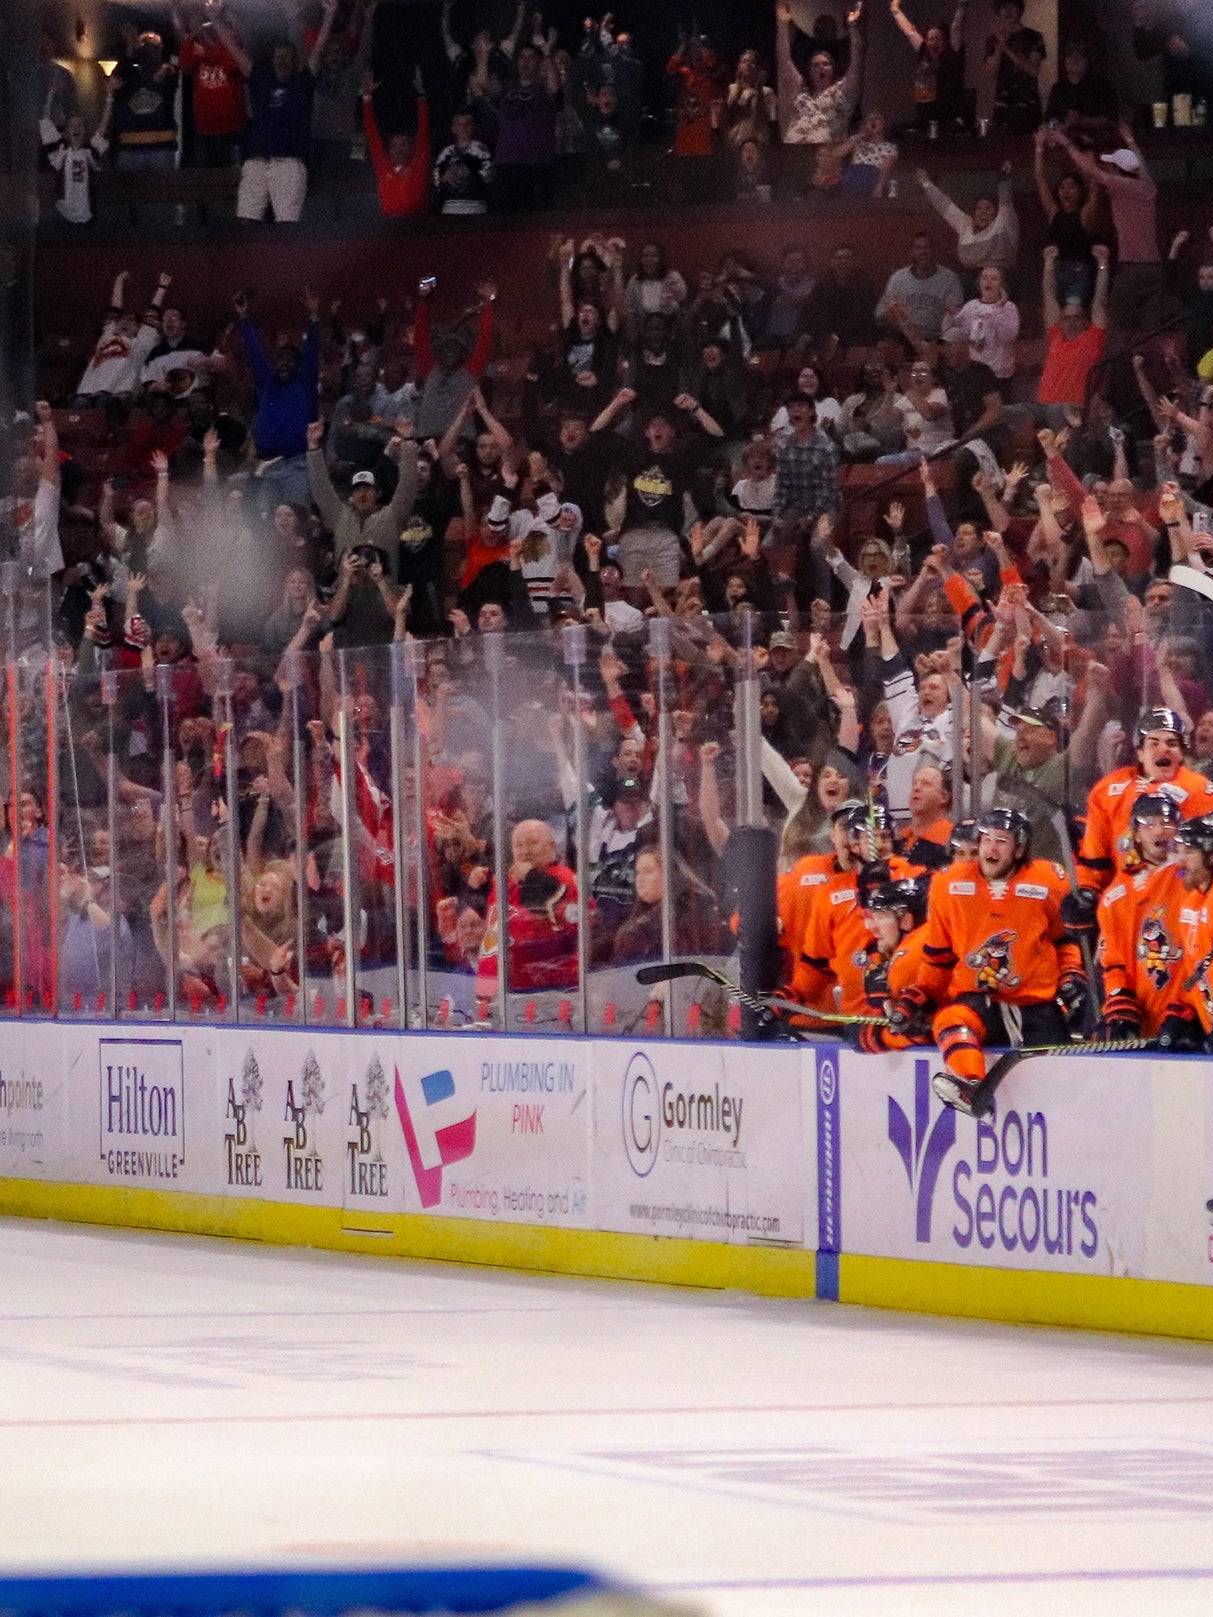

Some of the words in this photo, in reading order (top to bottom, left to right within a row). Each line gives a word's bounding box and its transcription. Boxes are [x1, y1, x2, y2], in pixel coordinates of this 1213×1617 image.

[107, 1065, 178, 1137] Hilton
[481, 1063, 556, 1092] PLUMBING
[559, 1064, 575, 1093] IN
[512, 1104, 545, 1134] PINK
[663, 1082, 743, 1148] Gormley
[107, 1150, 178, 1178] GREENVILLE
[224, 1134, 263, 1187] TREE
[283, 1137, 323, 1191] TREE
[347, 1141, 389, 1197] TREE
[976, 1110, 1049, 1179] Bon
[504, 1186, 545, 1218] Heating
[549, 1189, 569, 1214] and
[952, 1160, 1098, 1259] Secours
